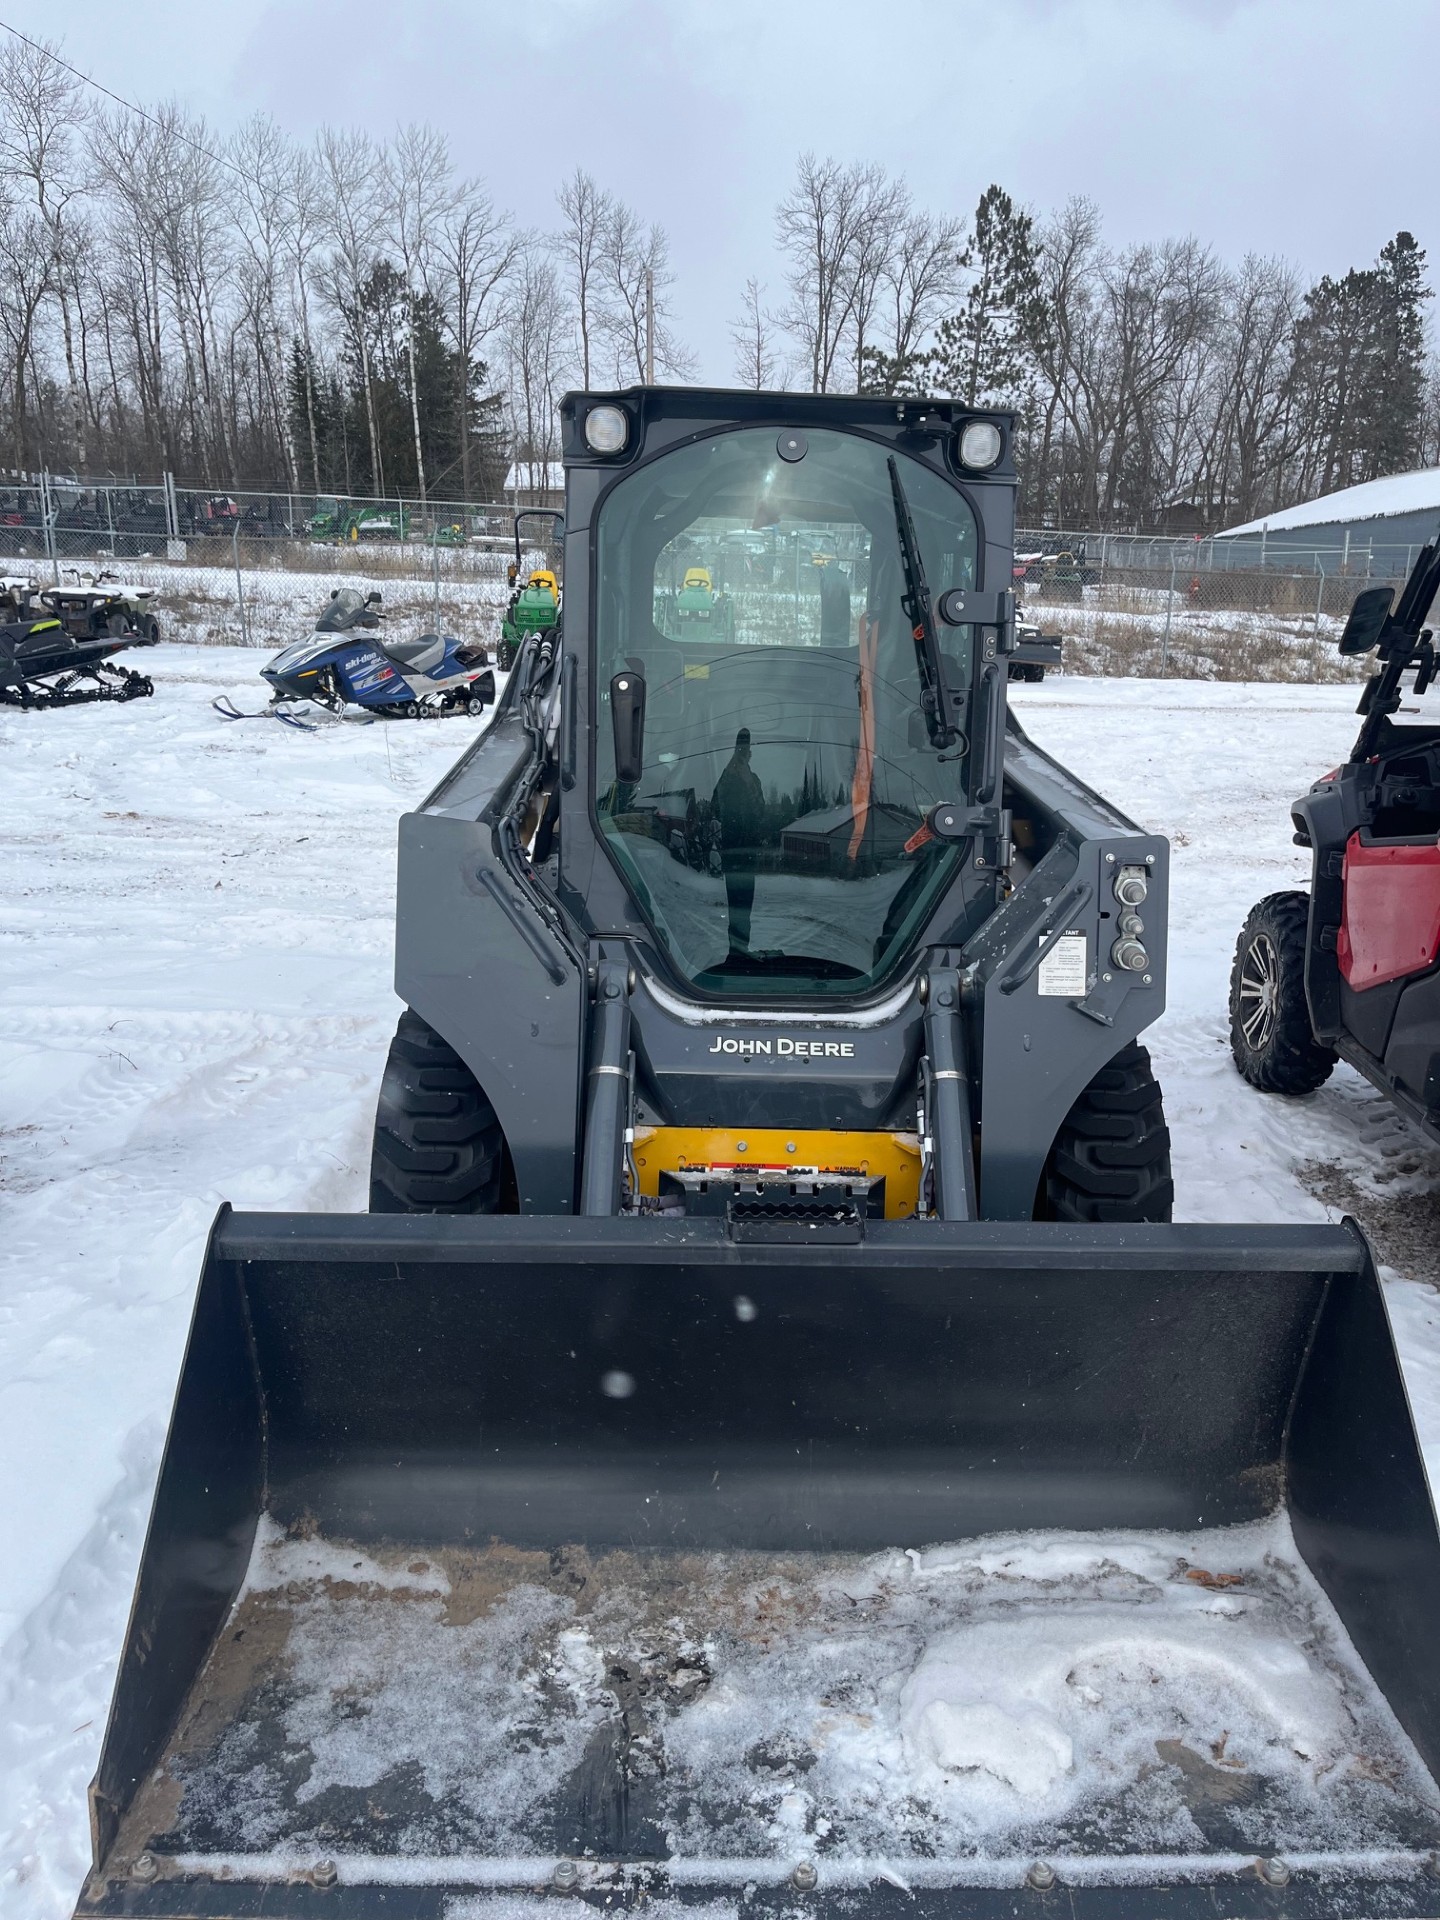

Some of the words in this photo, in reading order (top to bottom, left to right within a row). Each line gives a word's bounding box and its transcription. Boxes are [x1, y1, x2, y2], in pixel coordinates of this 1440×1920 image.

[345, 652, 377, 671] ski-doo
[709, 1036, 772, 1054] JOHN
[777, 1038, 855, 1057] DEERE
